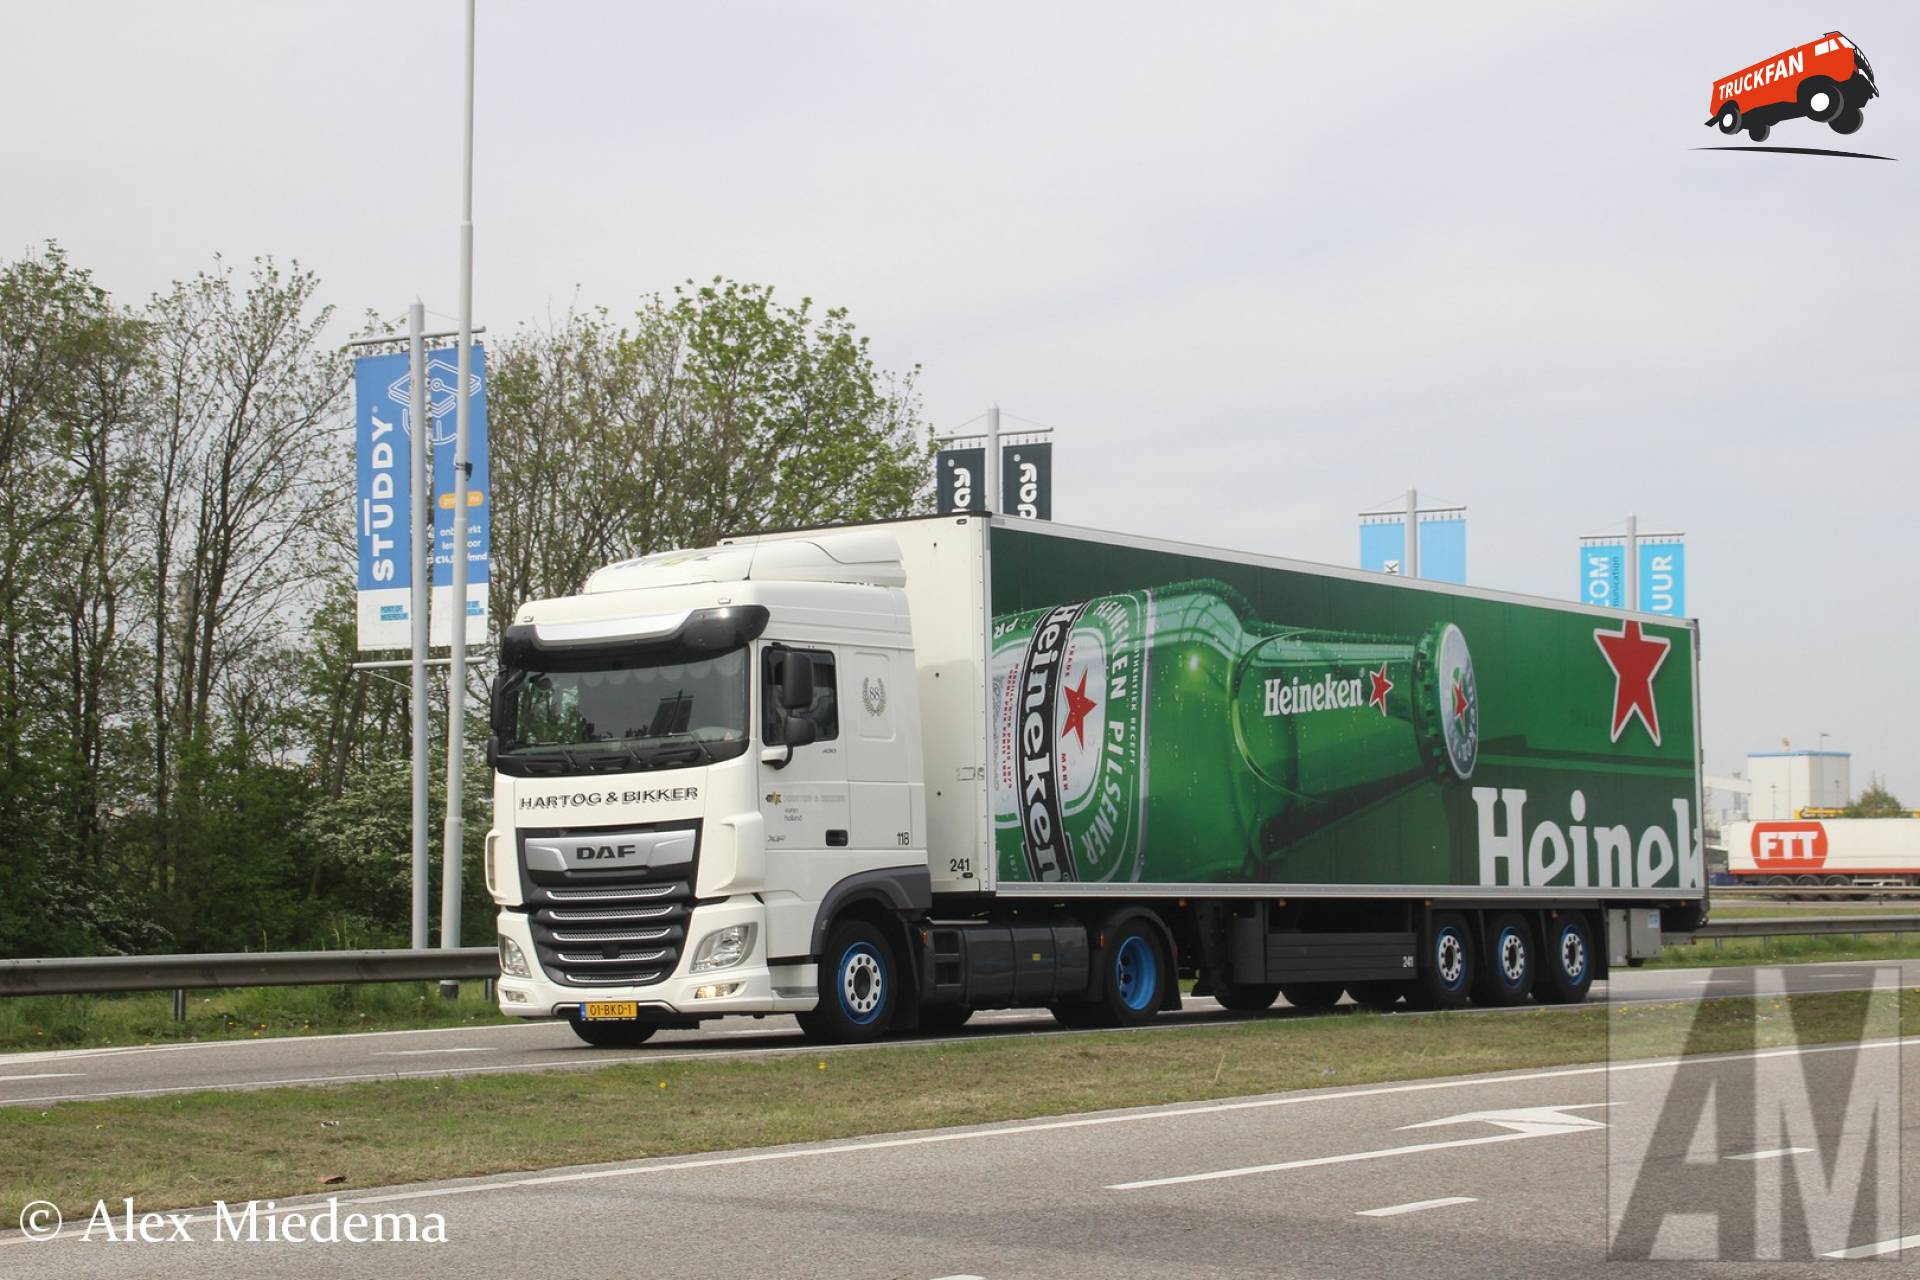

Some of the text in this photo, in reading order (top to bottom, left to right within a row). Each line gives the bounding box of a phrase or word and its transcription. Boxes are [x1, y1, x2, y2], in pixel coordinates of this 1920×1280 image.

[951, 467, 971, 513] ay
[1651, 554, 1673, 616] UUR
[1263, 673, 1364, 717] Heineken
[1022, 602, 1086, 882] Heineken
[1081, 601, 1130, 865] HEINEKEN PILSENER
[519, 786, 699, 811] HARTOG & BIKKER
[576, 845, 636, 860] DAF
[897, 832, 910, 845] 118
[1759, 831, 1818, 860] FTT
[950, 859, 970, 872] 241
